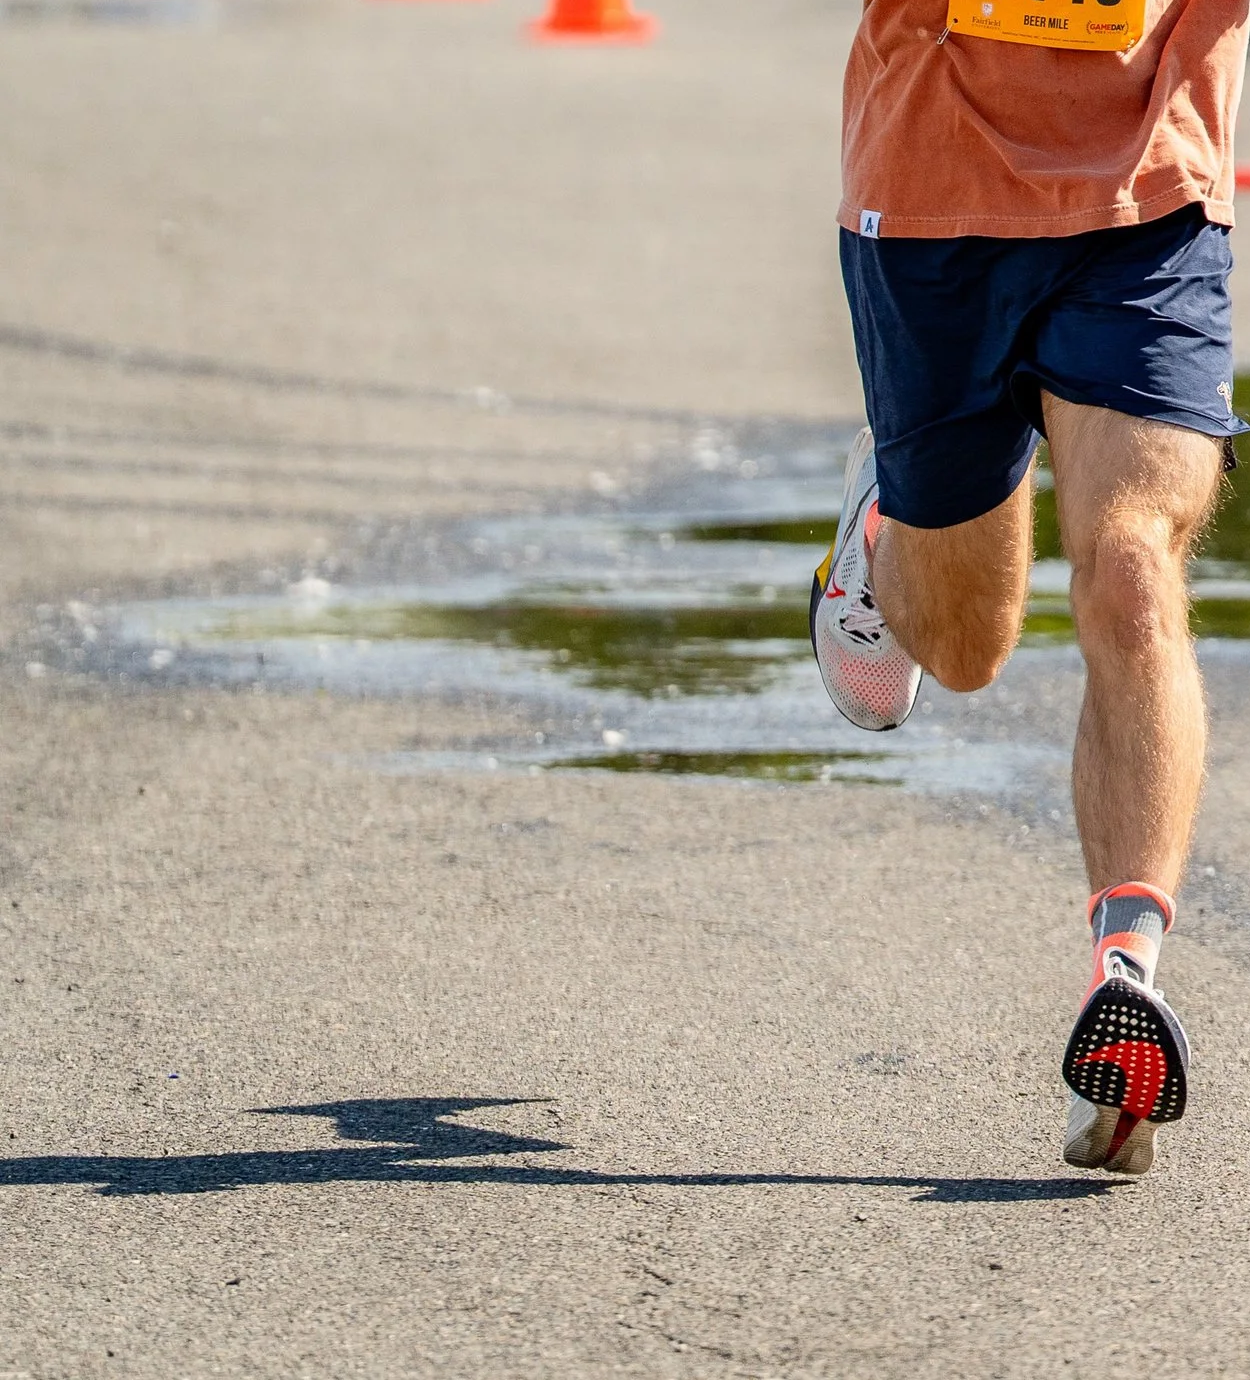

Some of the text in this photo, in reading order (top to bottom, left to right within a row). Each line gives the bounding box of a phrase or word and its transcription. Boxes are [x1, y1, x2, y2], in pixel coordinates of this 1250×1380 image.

[1023, 14, 1070, 30] BEER MILE
[1089, 23, 1126, 31] GAMEDAY
